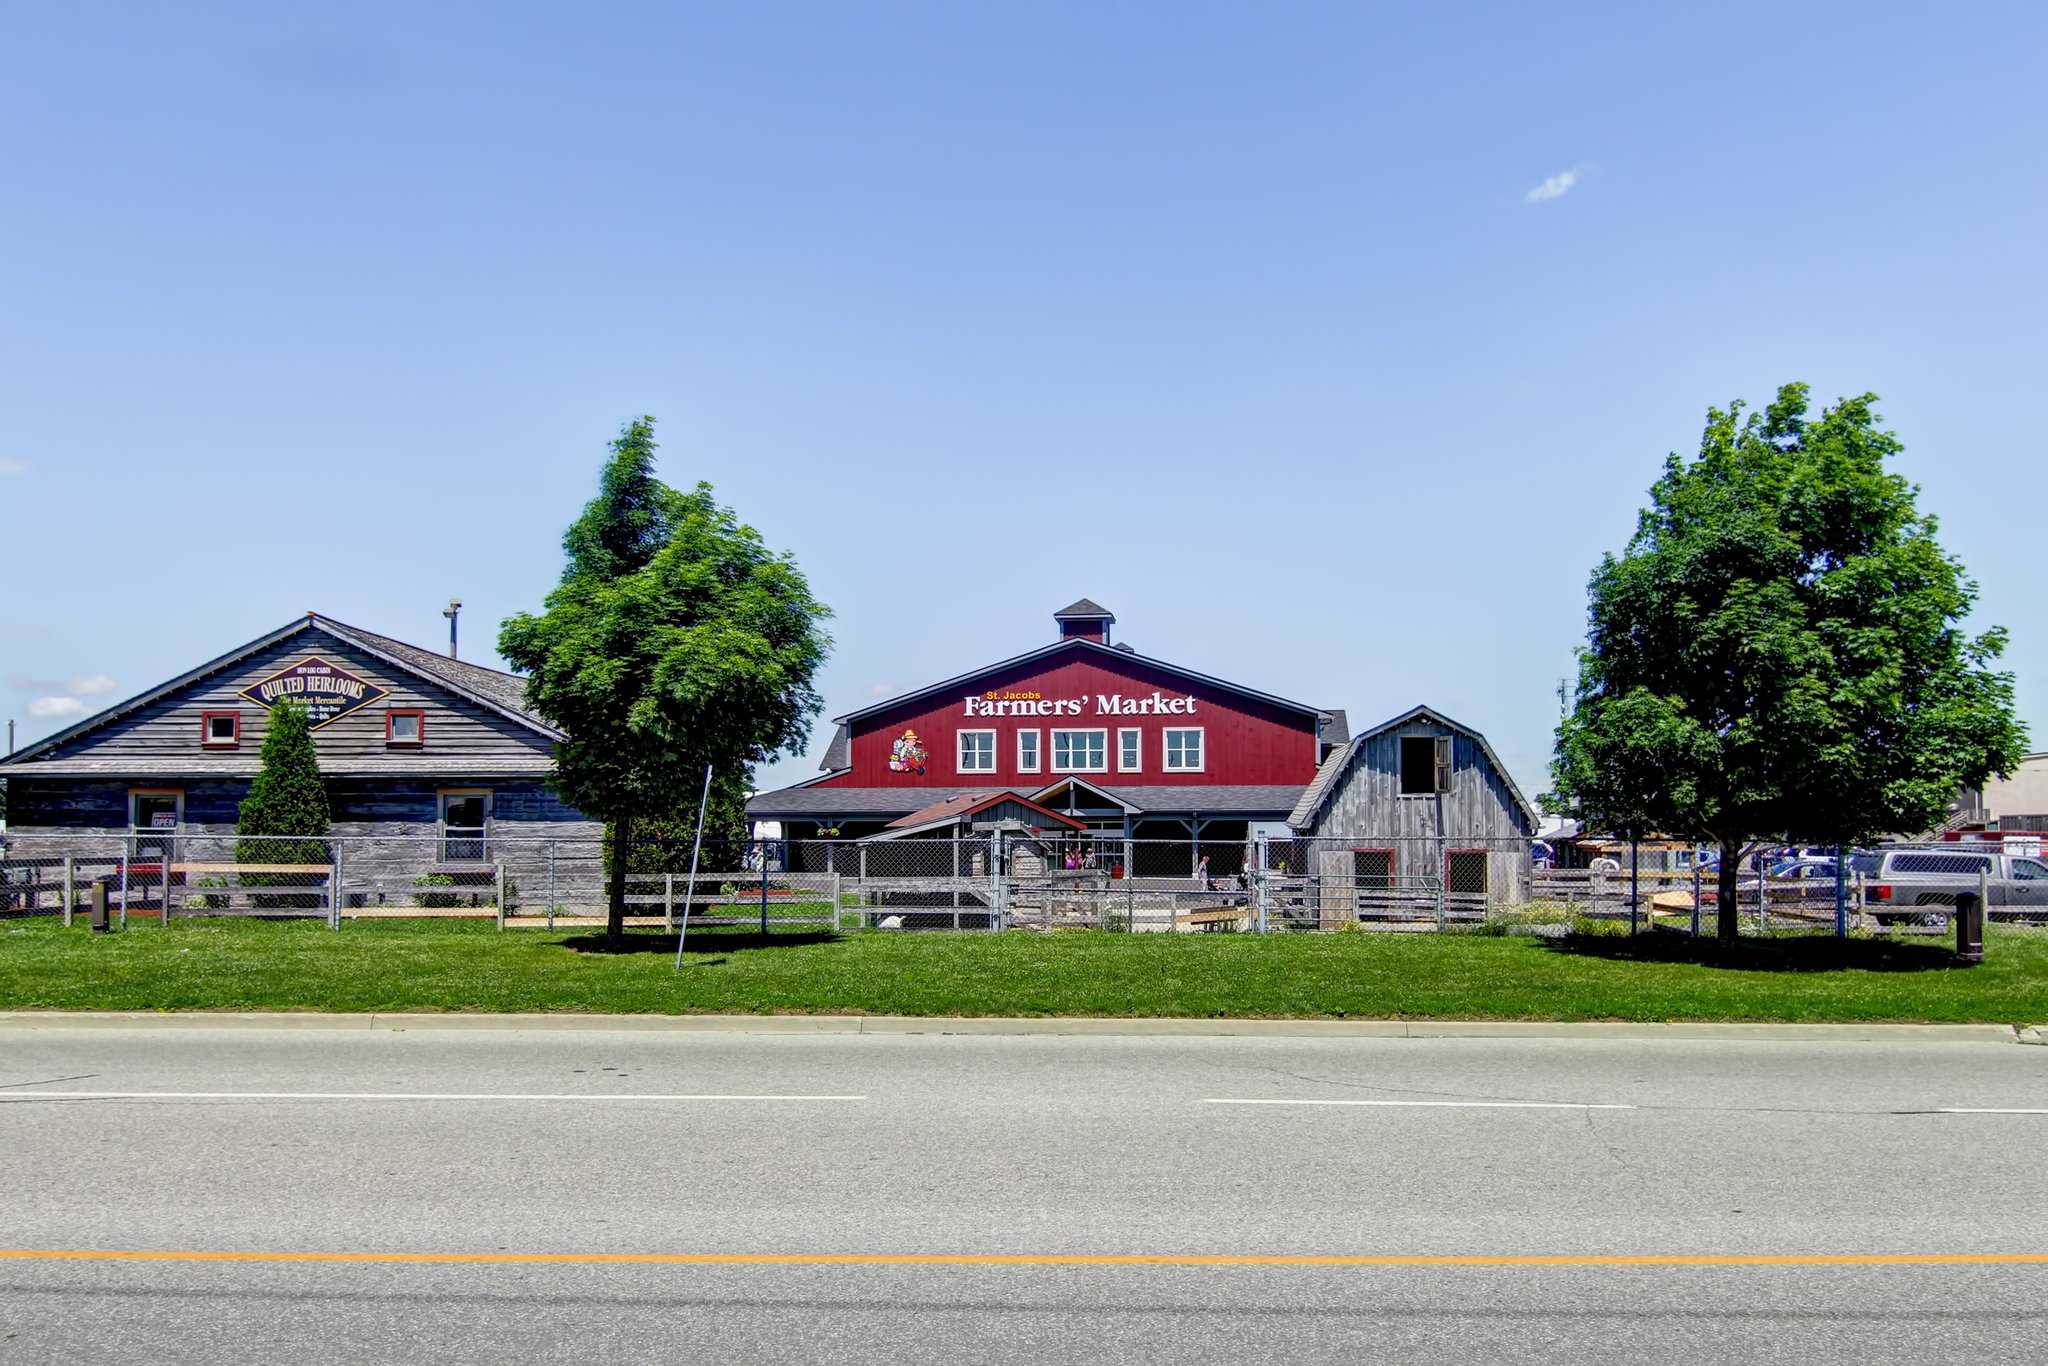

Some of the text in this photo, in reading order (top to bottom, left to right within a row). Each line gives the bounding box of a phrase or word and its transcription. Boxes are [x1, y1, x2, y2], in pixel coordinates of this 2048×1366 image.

[261, 676, 365, 701] QUILTED HEIRLOOMS
[292, 695, 314, 704] Market
[315, 695, 347, 704] Mercantile
[986, 691, 1041, 700] St. Jacobs
[1096, 692, 1197, 715] Market
[154, 818, 175, 827] OPEN
